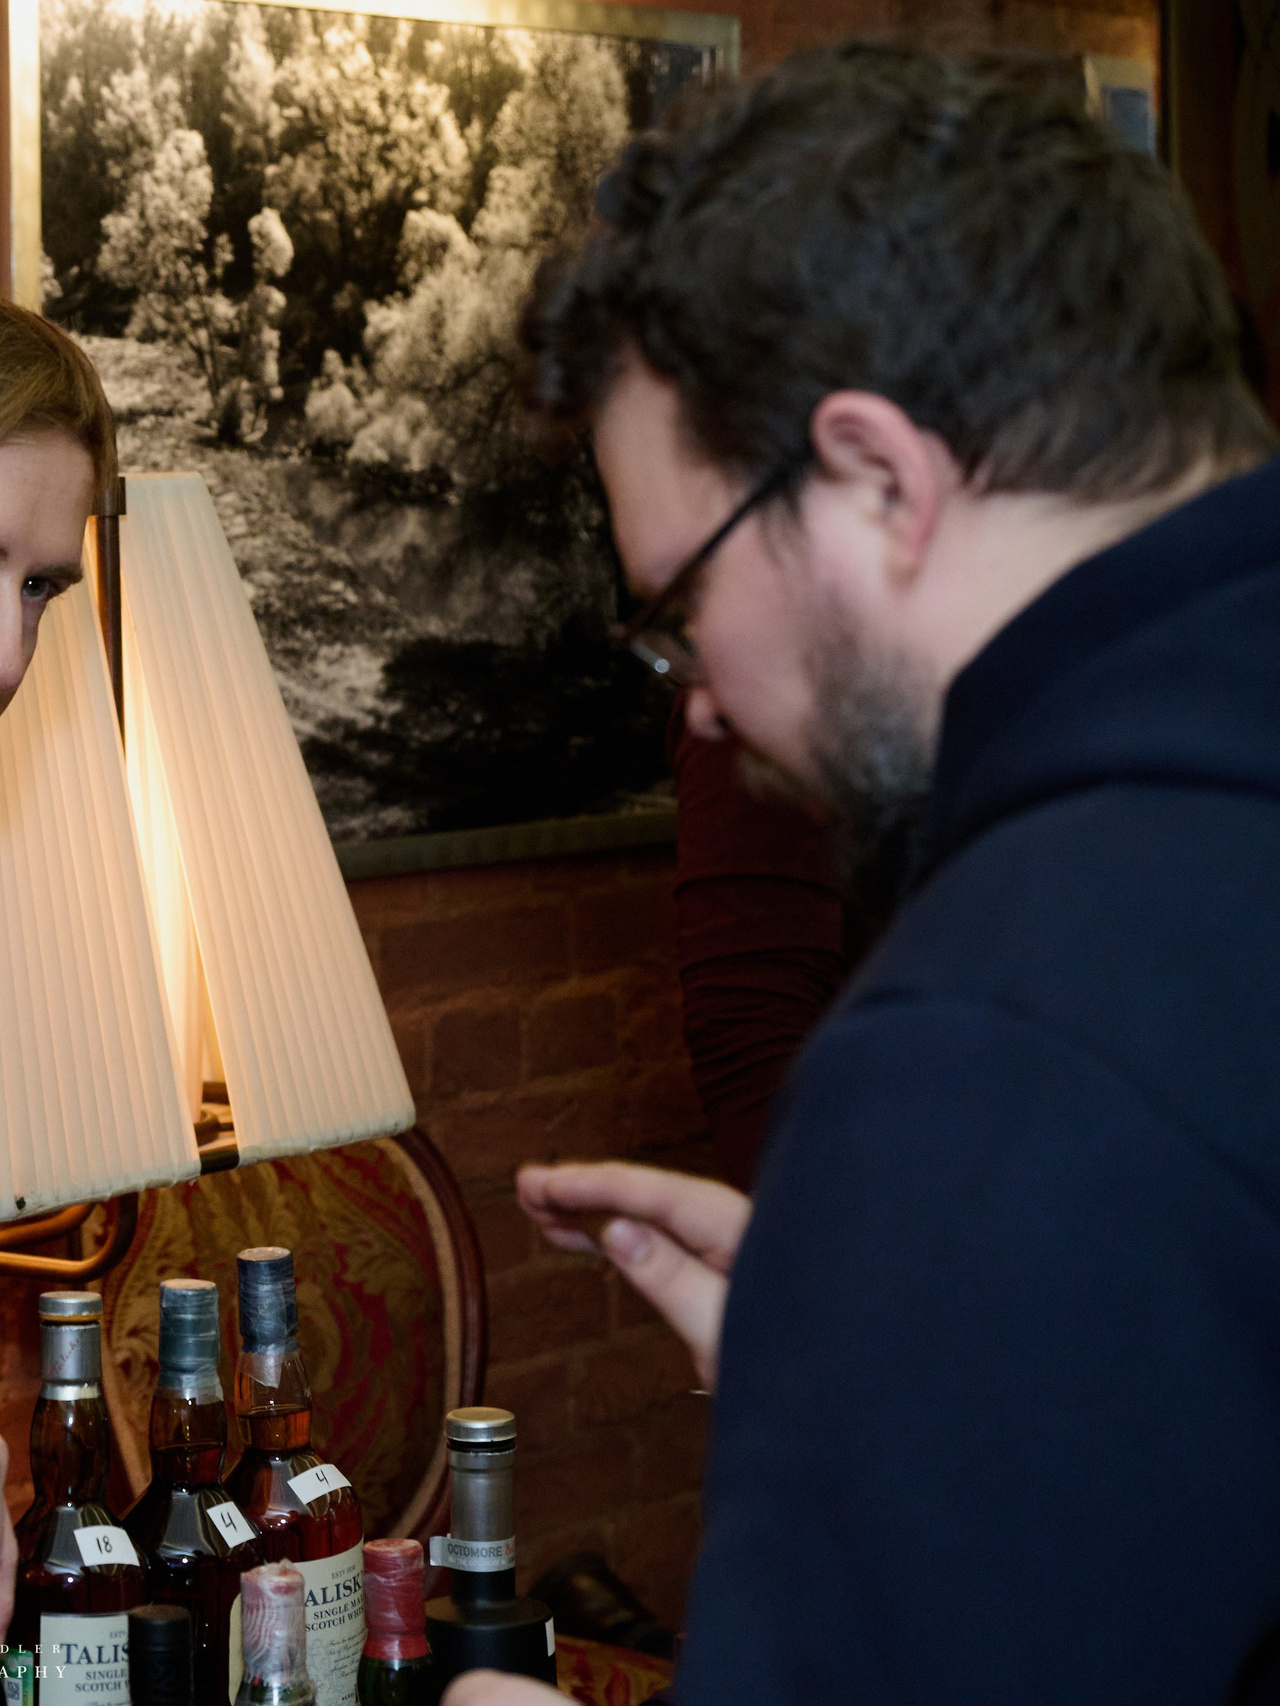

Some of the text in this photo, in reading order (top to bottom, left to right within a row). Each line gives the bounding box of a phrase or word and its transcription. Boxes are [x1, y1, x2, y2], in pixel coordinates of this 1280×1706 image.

[316, 1469, 330, 1488] 4
[221, 1511, 239, 1533] 4
[95, 1535, 113, 1554] 18
[447, 1542, 503, 1558] OCTOMORE
[313, 1603, 349, 1620] SINGLE
[85, 1668, 127, 1680] SINGLE
[75, 1681, 122, 1693] SCOTCH
